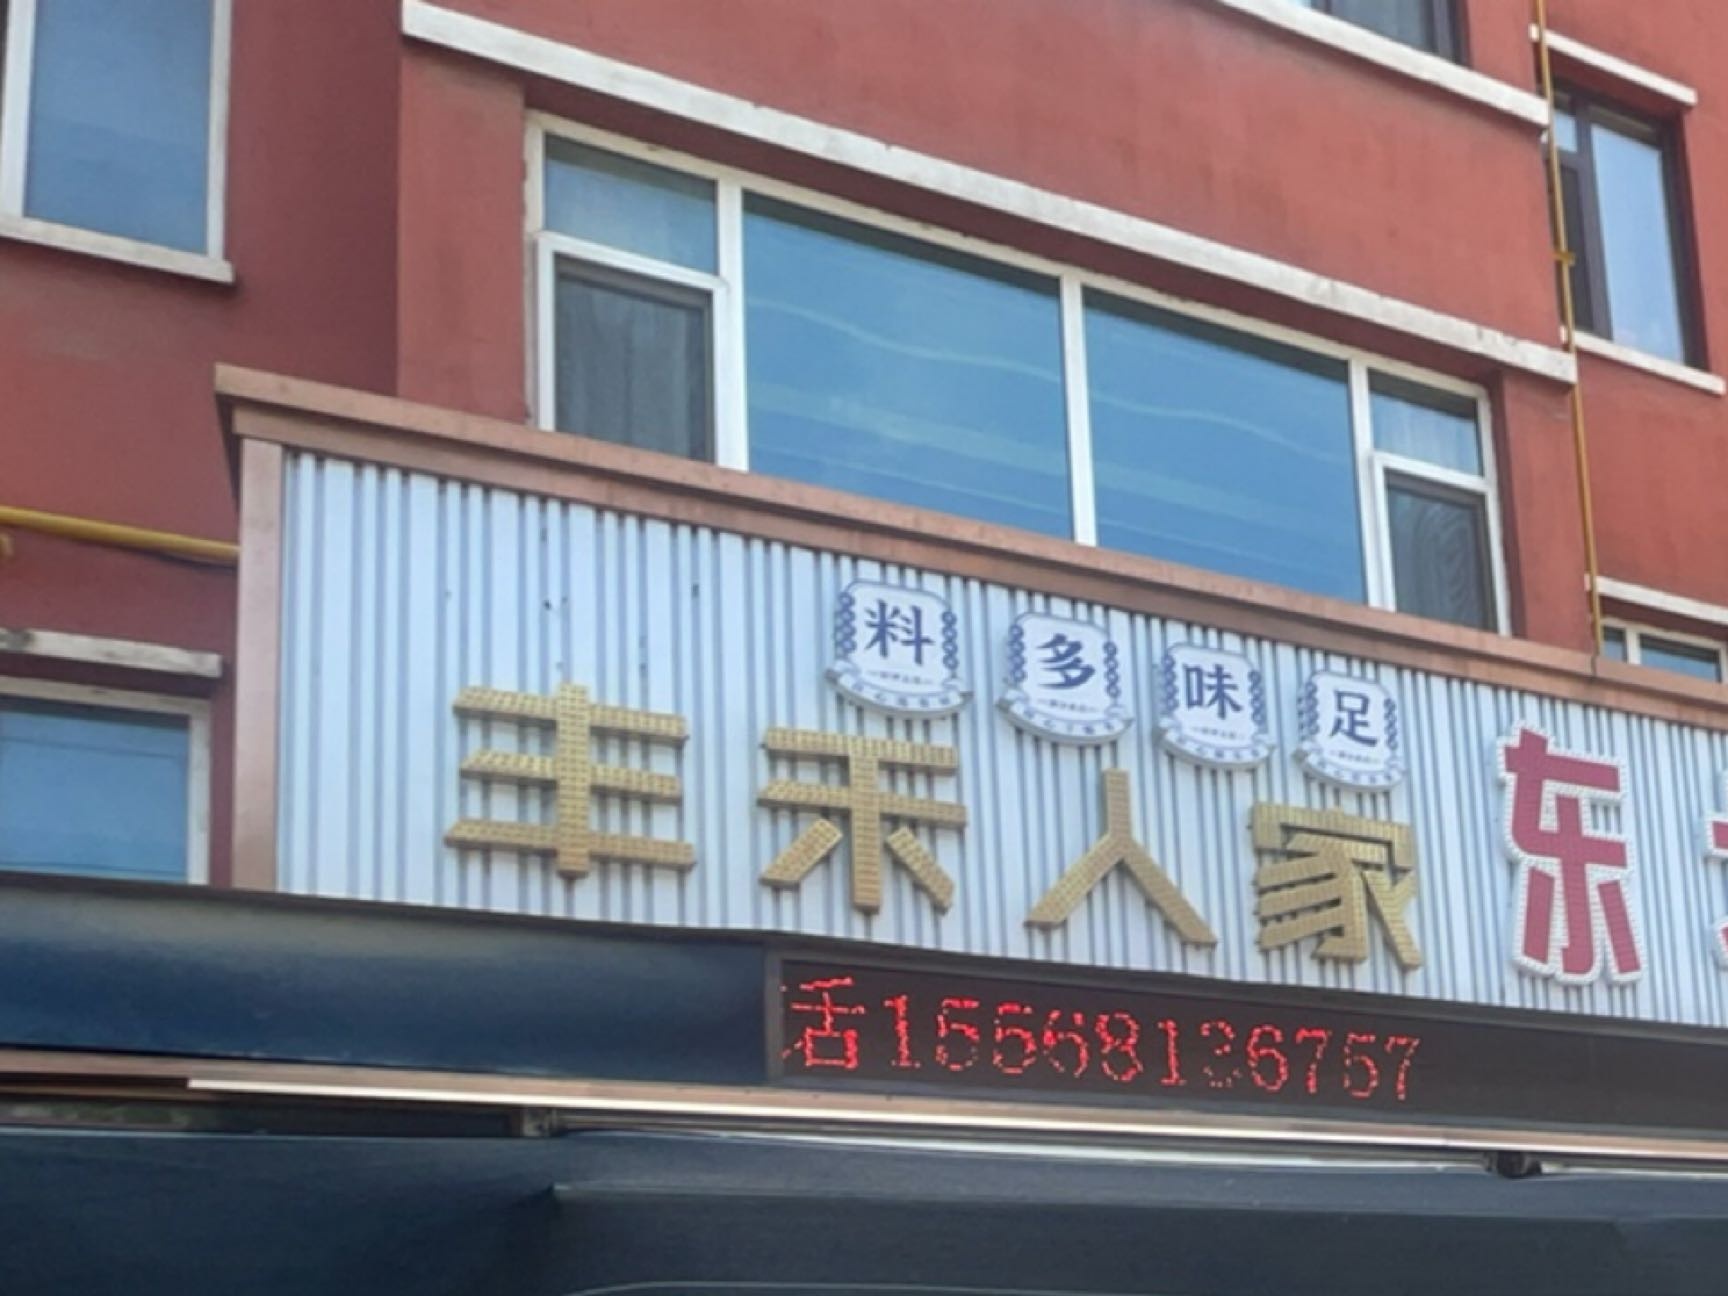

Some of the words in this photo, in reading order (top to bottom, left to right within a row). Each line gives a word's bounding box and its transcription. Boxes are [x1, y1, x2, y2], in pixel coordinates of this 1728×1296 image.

[864, 599, 1378, 748] 料多味足
[444, 682, 1423, 971] 丰禾人家
